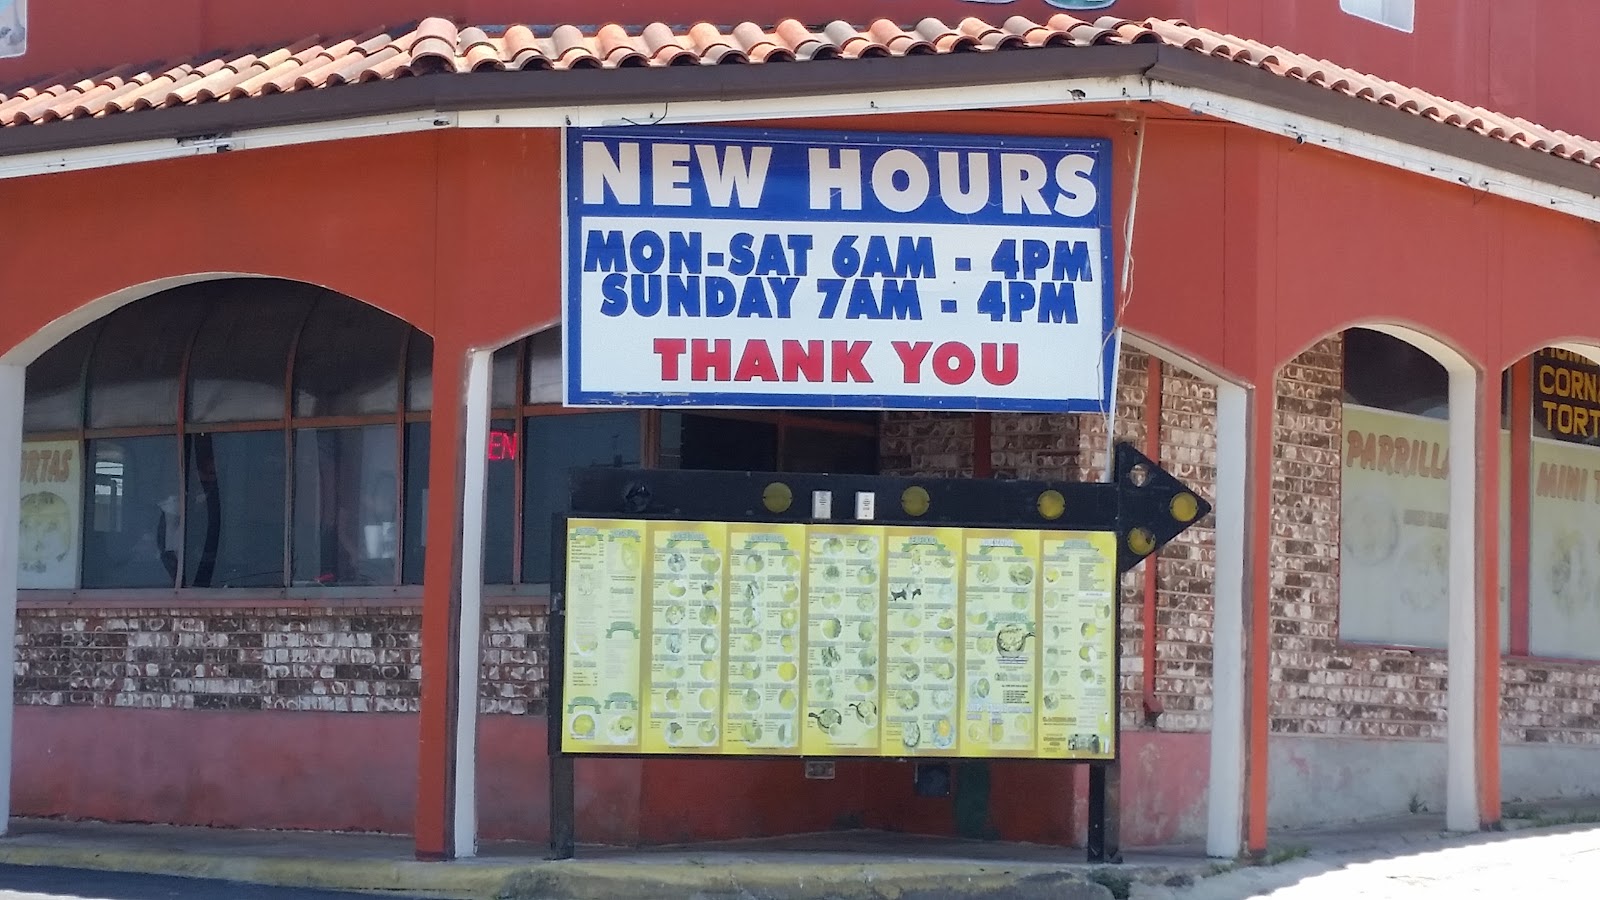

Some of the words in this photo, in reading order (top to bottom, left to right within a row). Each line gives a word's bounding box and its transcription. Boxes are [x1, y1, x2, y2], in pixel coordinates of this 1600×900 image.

[582, 141, 773, 208] NEW
[808, 147, 1098, 218] HOURS
[583, 230, 814, 277] MON-SAT
[831, 234, 936, 279] 6AM
[954, 256, 971, 272] -
[990, 238, 1093, 282] 4PM
[600, 273, 800, 318] SUNDAY
[817, 278, 923, 321] 7AM
[940, 299, 957, 313] -
[977, 281, 1079, 324] 4PM
[653, 337, 874, 384] THANK
[891, 340, 1019, 386] YOU
